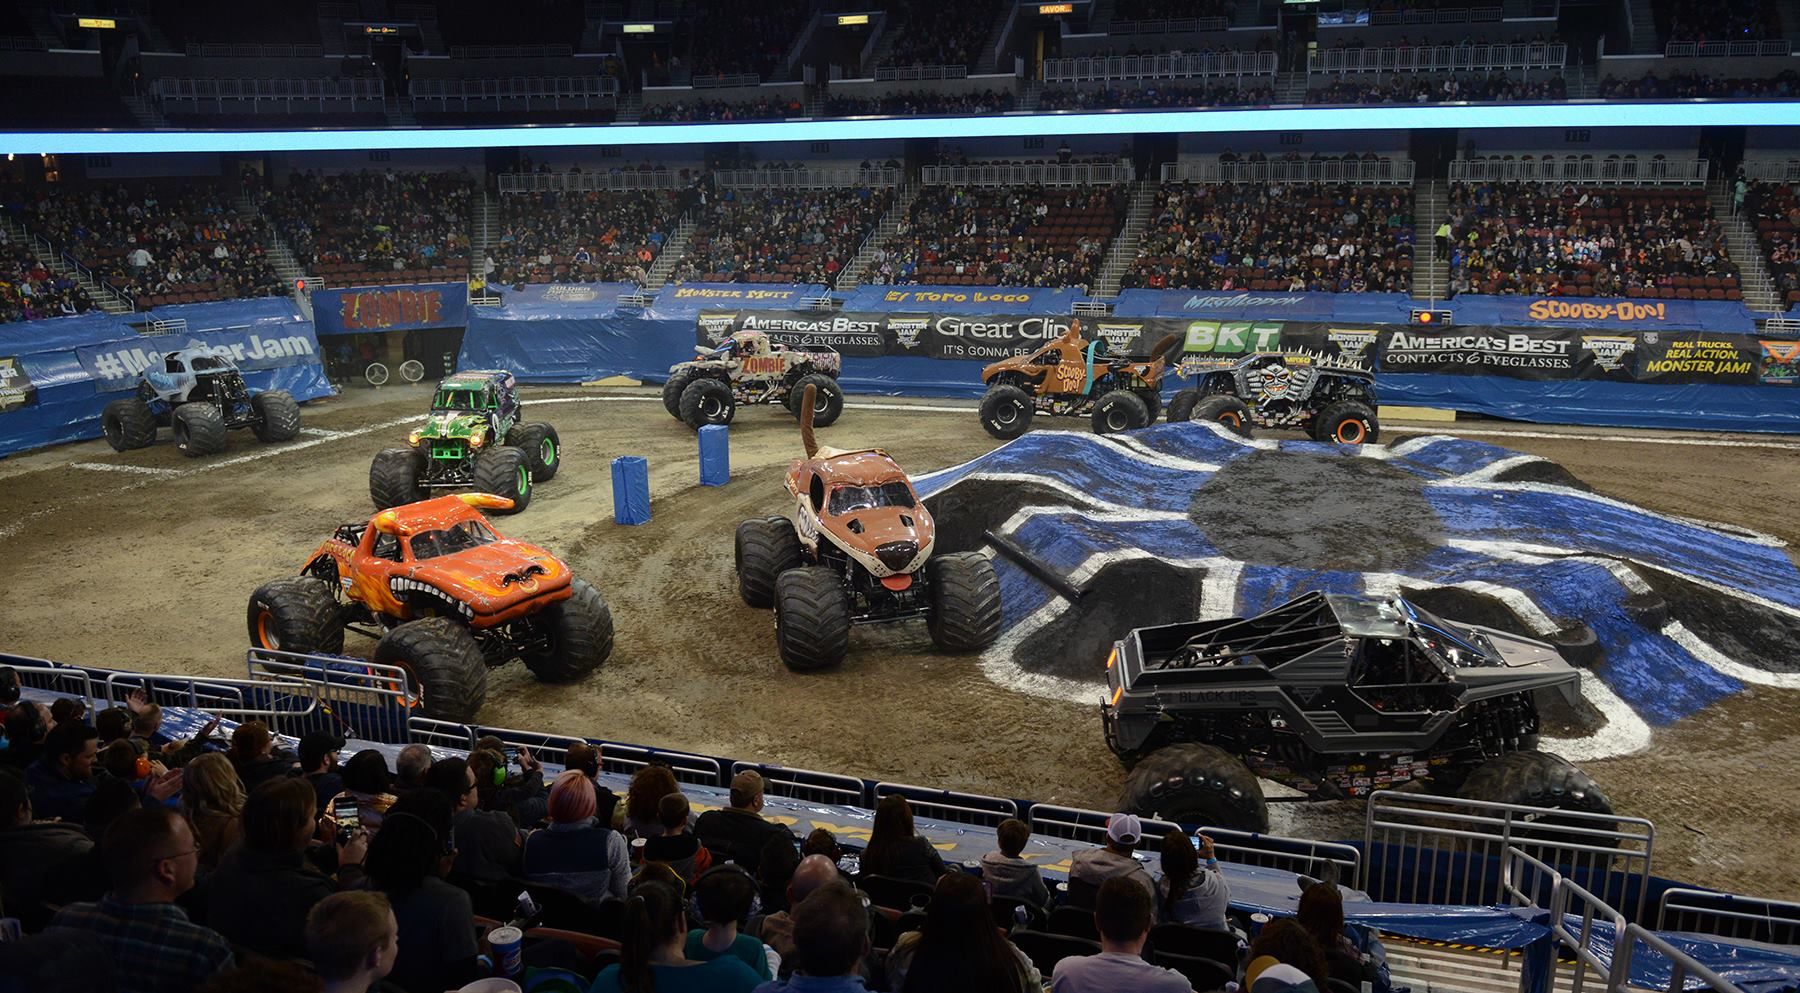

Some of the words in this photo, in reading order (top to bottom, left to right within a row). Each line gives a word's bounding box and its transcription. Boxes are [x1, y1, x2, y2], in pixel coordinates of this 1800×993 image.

[675, 288, 743, 299] MONSTER
[341, 288, 443, 329] ZOMBIE
[1183, 293, 1305, 310] MEGALODON
[1529, 300, 1665, 321] SCOOBY-DOO!
[742, 316, 832, 331] AMERICA'S
[832, 317, 880, 333] BEST
[936, 316, 1013, 339] Great
[1097, 329, 1142, 337] MONSTER
[1186, 326, 1280, 348] BKT
[1328, 334, 1377, 344] MONSTER
[1342, 341, 1363, 349] JAM
[1387, 332, 1507, 351] AMERICA'S
[1508, 334, 1571, 354] BEST
[1582, 341, 1636, 352] MONSTER
[1672, 341, 1695, 349] REAL
[1696, 341, 1734, 350] TRUCKS.
[943, 344, 964, 355] IT'S
[968, 345, 1010, 358] GONNA
[1014, 347, 1030, 357] BE
[1387, 352, 1465, 364] CONTACTS
[1600, 348, 1622, 357] JAM
[1665, 349, 1692, 359] REAL
[1693, 349, 1739, 361] ACTION.
[742, 356, 786, 375] ZOMBIE
[1646, 359, 1714, 374] MONSTER
[1713, 360, 1752, 375] JAM!
[1063, 378, 1080, 392] DOO!
[1178, 690, 1223, 704] BLACK
[1229, 690, 1257, 703] OPS
